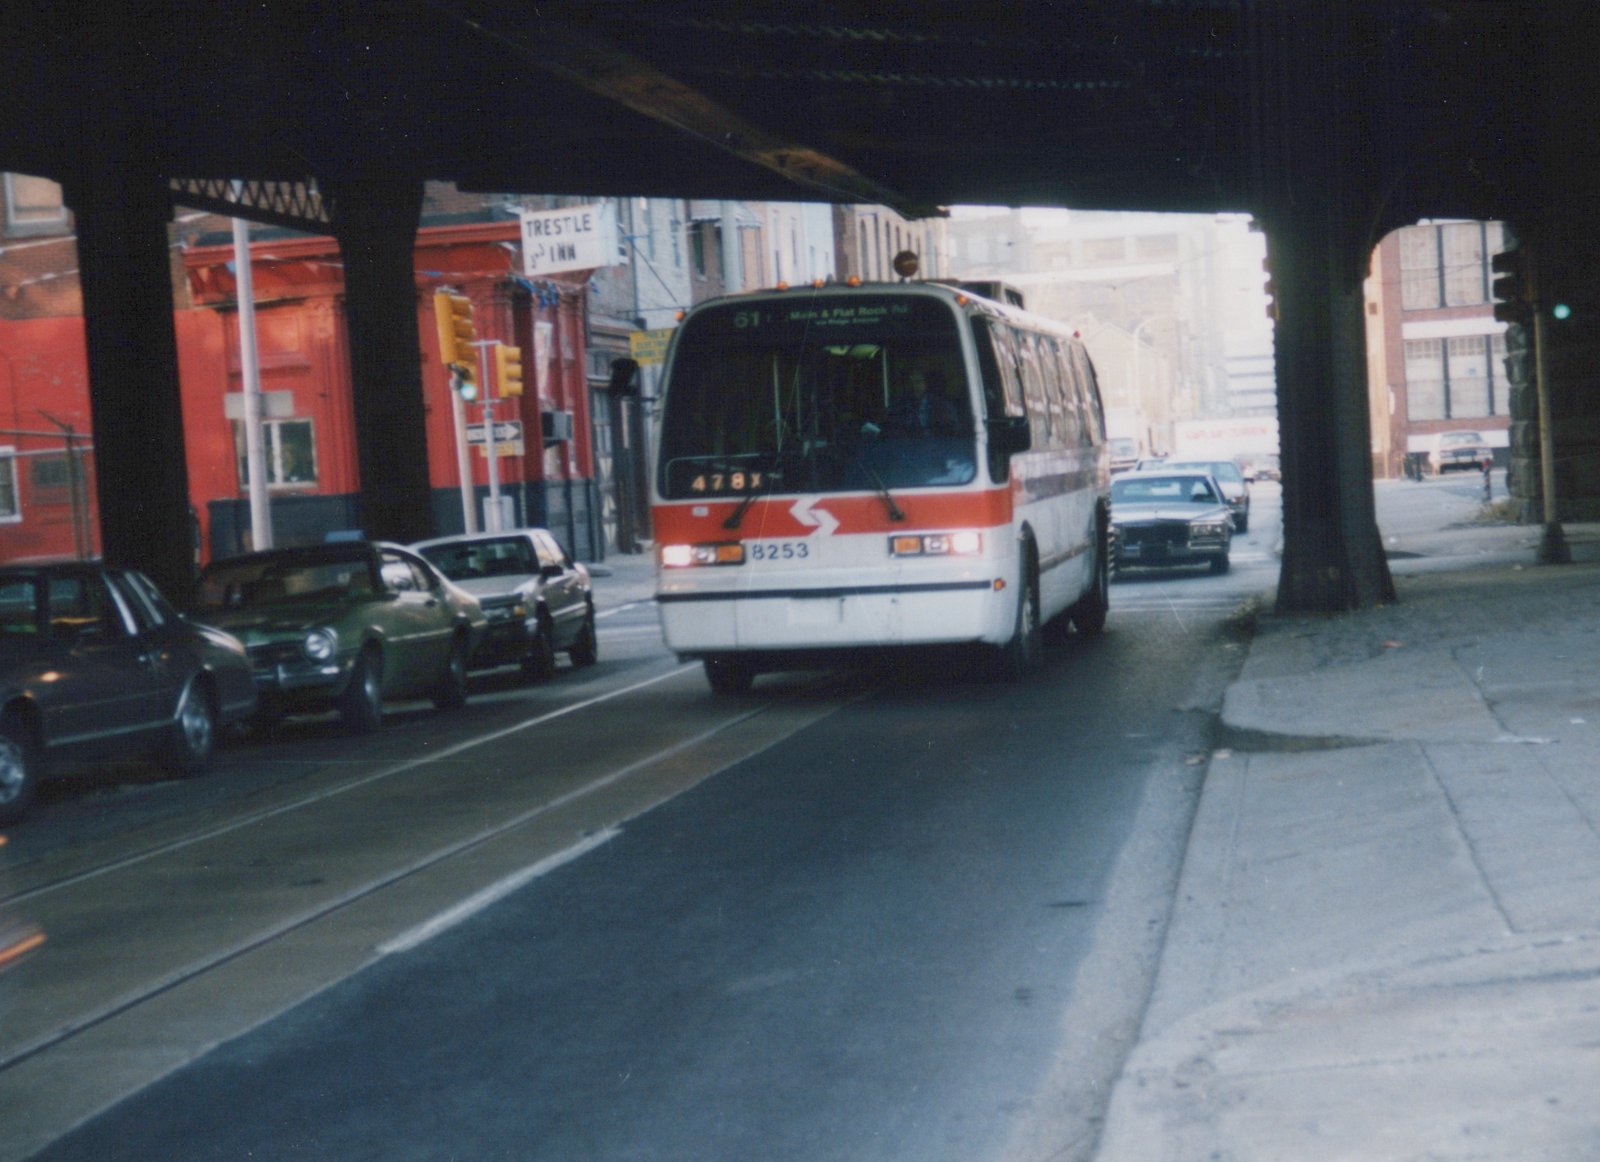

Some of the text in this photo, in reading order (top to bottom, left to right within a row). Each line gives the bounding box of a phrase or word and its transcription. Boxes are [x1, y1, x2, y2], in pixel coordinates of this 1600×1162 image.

[525, 213, 592, 238] TRESTLE
[549, 242, 576, 263] INN
[734, 312, 761, 328] 61
[833, 307, 855, 317] Flat
[858, 305, 888, 316] Rock
[752, 542, 809, 560] 8253
